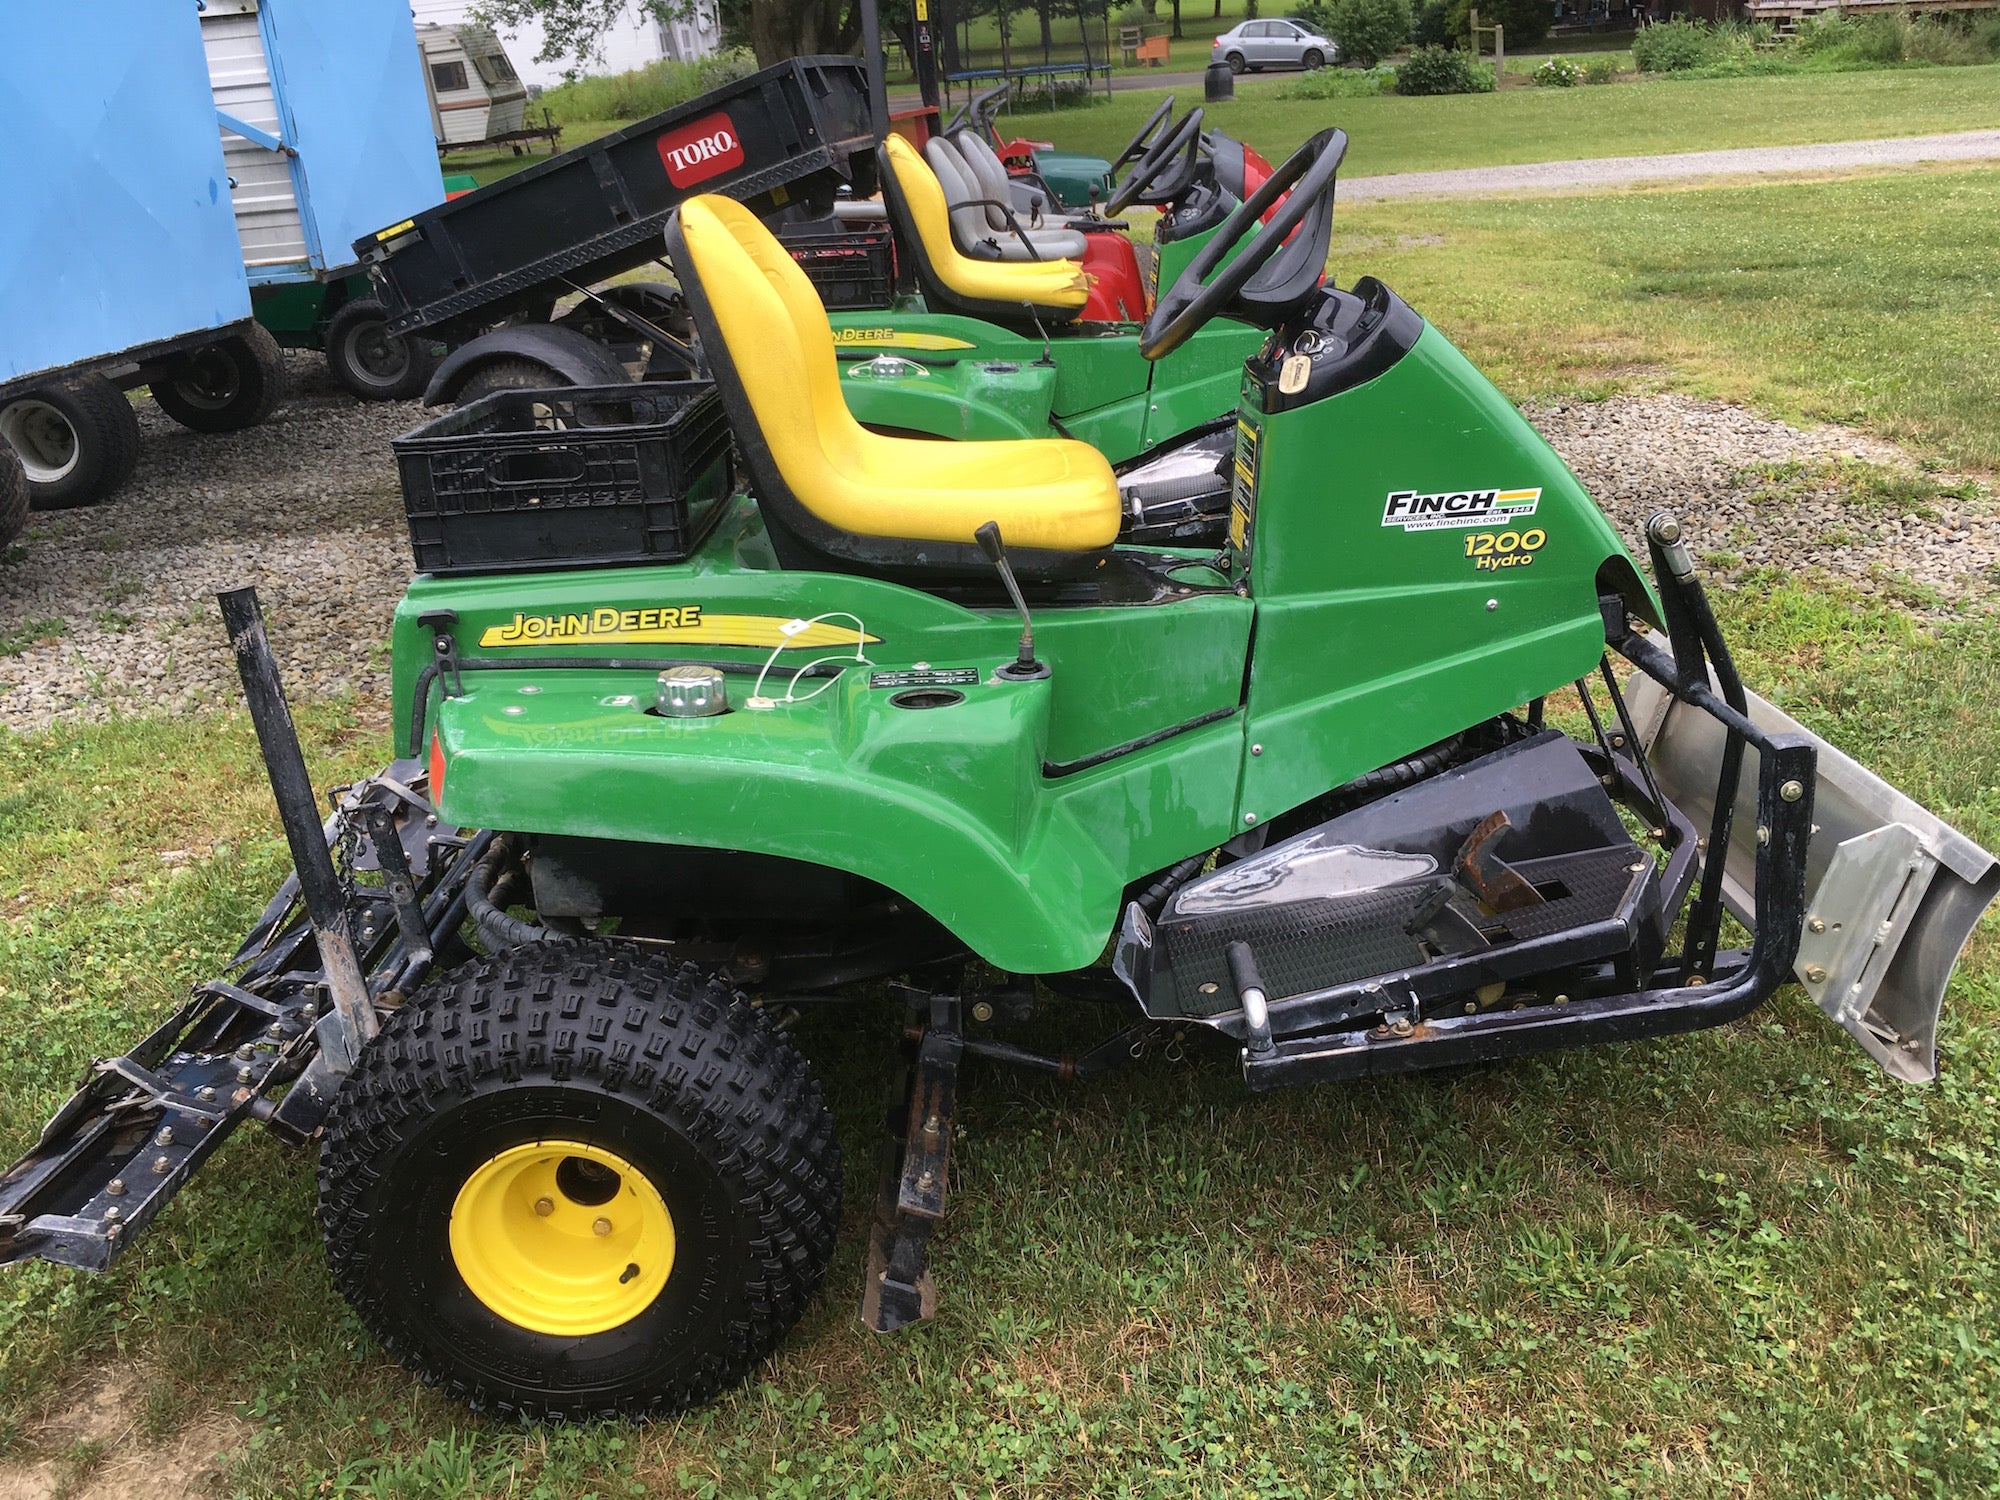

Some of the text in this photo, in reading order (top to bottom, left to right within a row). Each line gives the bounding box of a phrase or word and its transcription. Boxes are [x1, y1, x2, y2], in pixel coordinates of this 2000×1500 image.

[667, 131, 732, 171] TORO
[843, 328, 893, 340] DEERE
[1387, 492, 1495, 516] FINCH
[1407, 516, 1507, 529] www.finchinc.com
[1465, 528, 1547, 557] 1200
[1476, 553, 1533, 571] Hydro
[503, 606, 701, 639] JOHN DEERE
